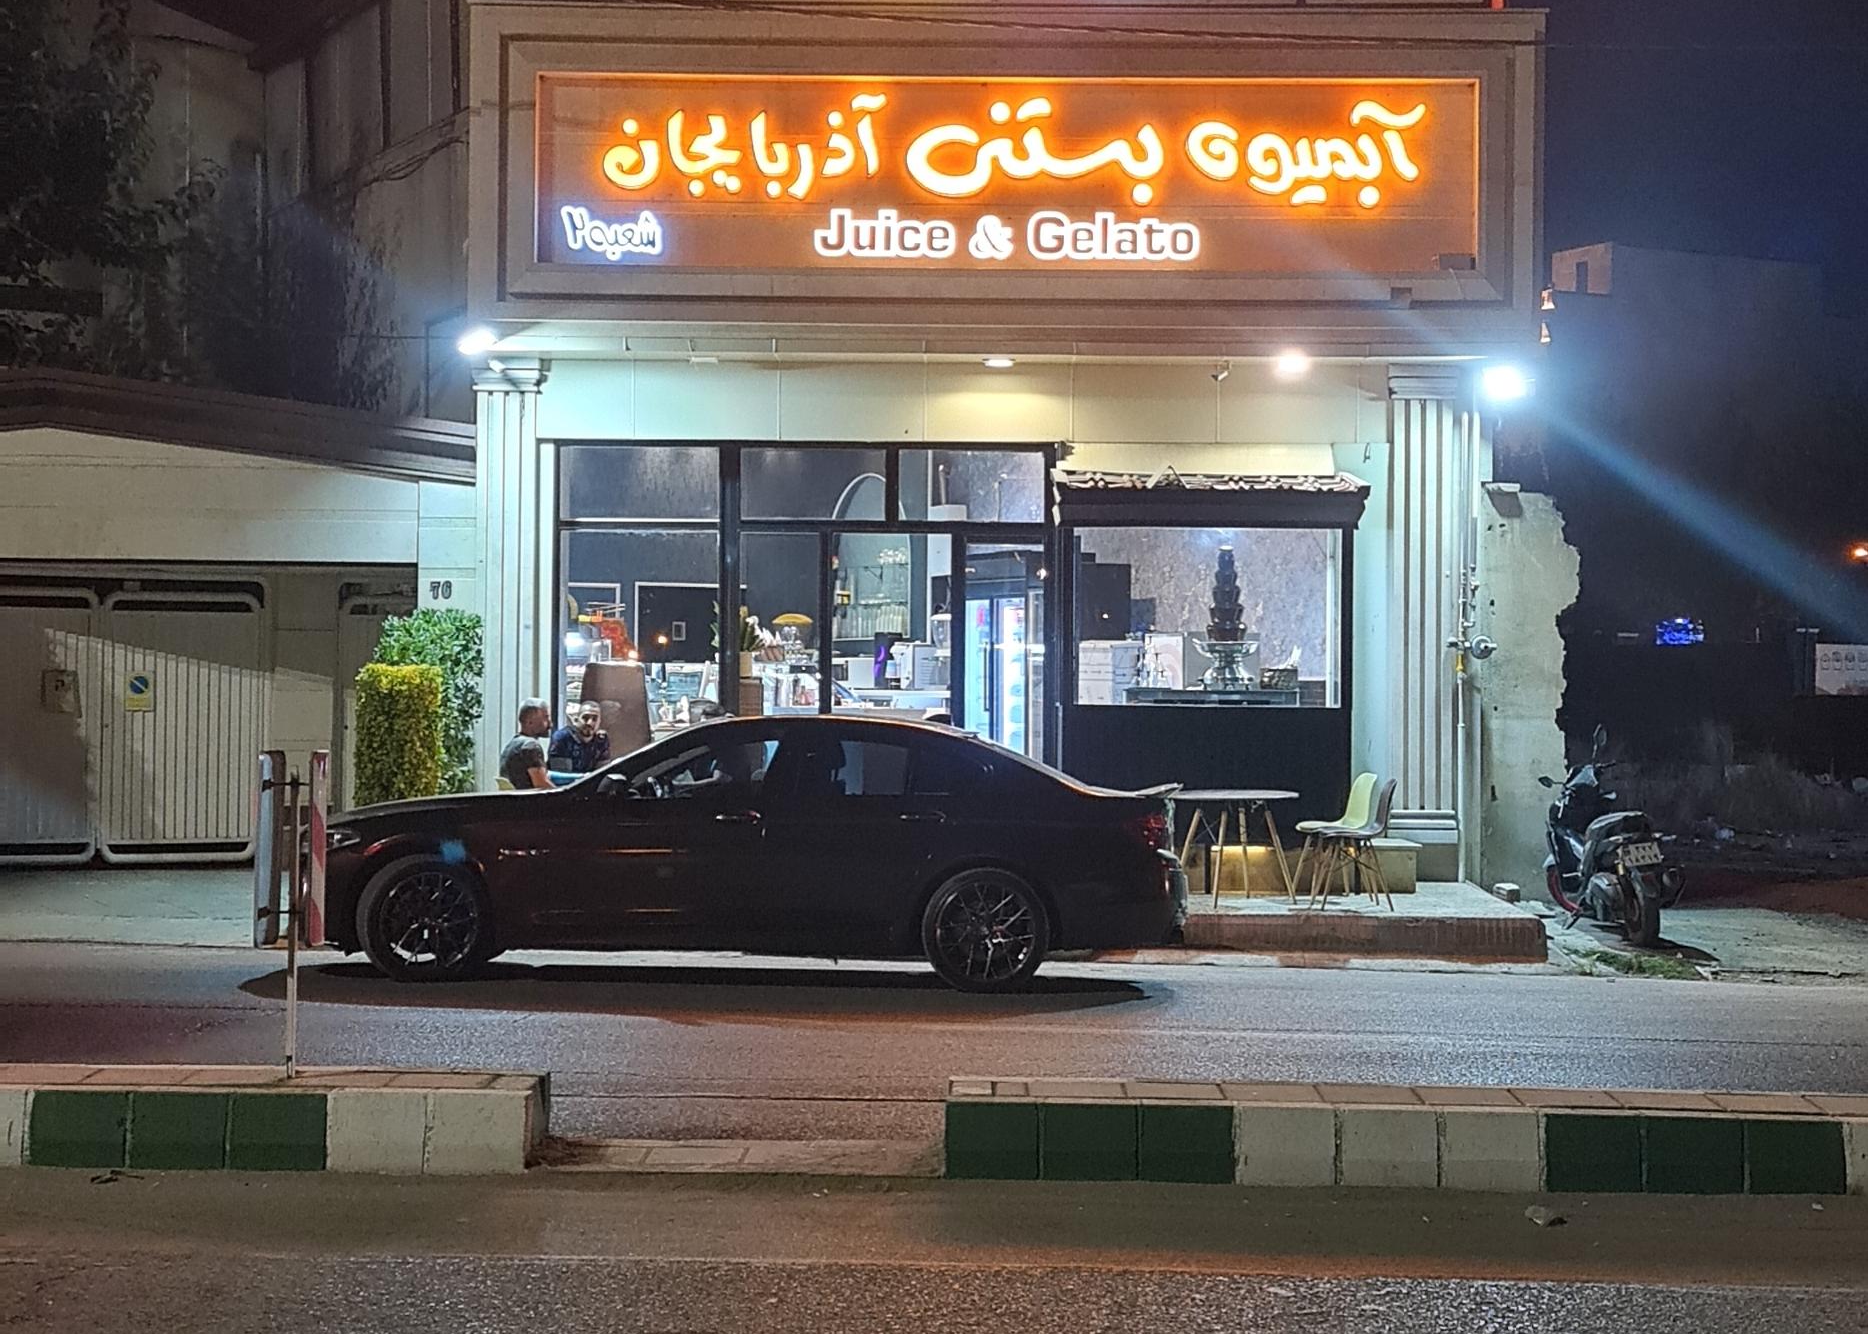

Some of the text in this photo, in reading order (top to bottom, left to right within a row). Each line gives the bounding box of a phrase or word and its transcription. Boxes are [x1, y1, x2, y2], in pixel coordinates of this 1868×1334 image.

[603, 93, 1426, 208] آبمیوه بستنی آذربایجان
[586, 212, 661, 259] شعبه
[816, 210, 1199, 258] Juice & Gelato
[430, 580, 452, 600] 76
